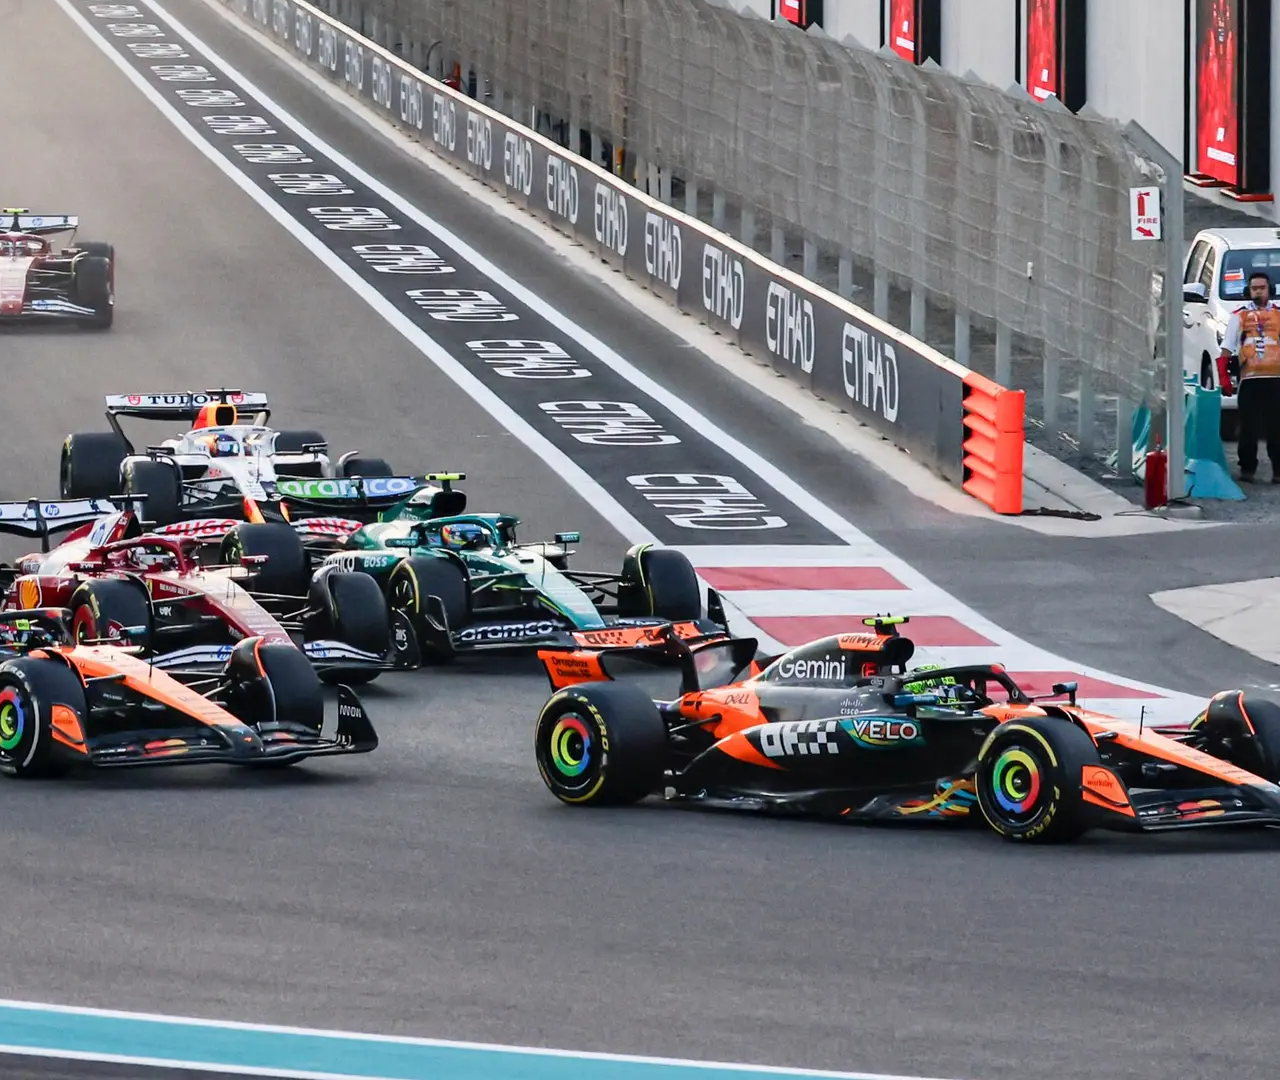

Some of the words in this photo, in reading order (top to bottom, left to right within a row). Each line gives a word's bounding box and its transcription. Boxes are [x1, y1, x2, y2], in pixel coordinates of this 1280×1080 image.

[433, 93, 456, 151] ETIHAD
[467, 111, 492, 170] ETIHAD
[268, 173, 355, 196] ETIHAD
[505, 132, 533, 195] ETIHAD
[547, 155, 579, 224] ETIHAD
[307, 206, 402, 231] ETIHAD
[595, 182, 628, 256] ETIHAD
[1137, 216, 1158, 224] FIRE
[352, 244, 457, 274] ETIHAD
[646, 212, 681, 290] ETIHAD
[405, 289, 519, 322] ETIHAD
[702, 243, 744, 330] ETIHAD
[766, 281, 814, 374] ETIHAD
[465, 340, 592, 379] ETIHAD
[842, 322, 899, 423] ETIHAD
[538, 401, 681, 446] ETIHAD
[626, 474, 788, 530] ETIHAD
[166, 520, 239, 536] HUGO
[364, 556, 388, 568] BOSS
[461, 620, 553, 640] aramco
[778, 654, 846, 680] Gemini
[588, 704, 611, 752] ZERO
[853, 720, 918, 740] VELO
